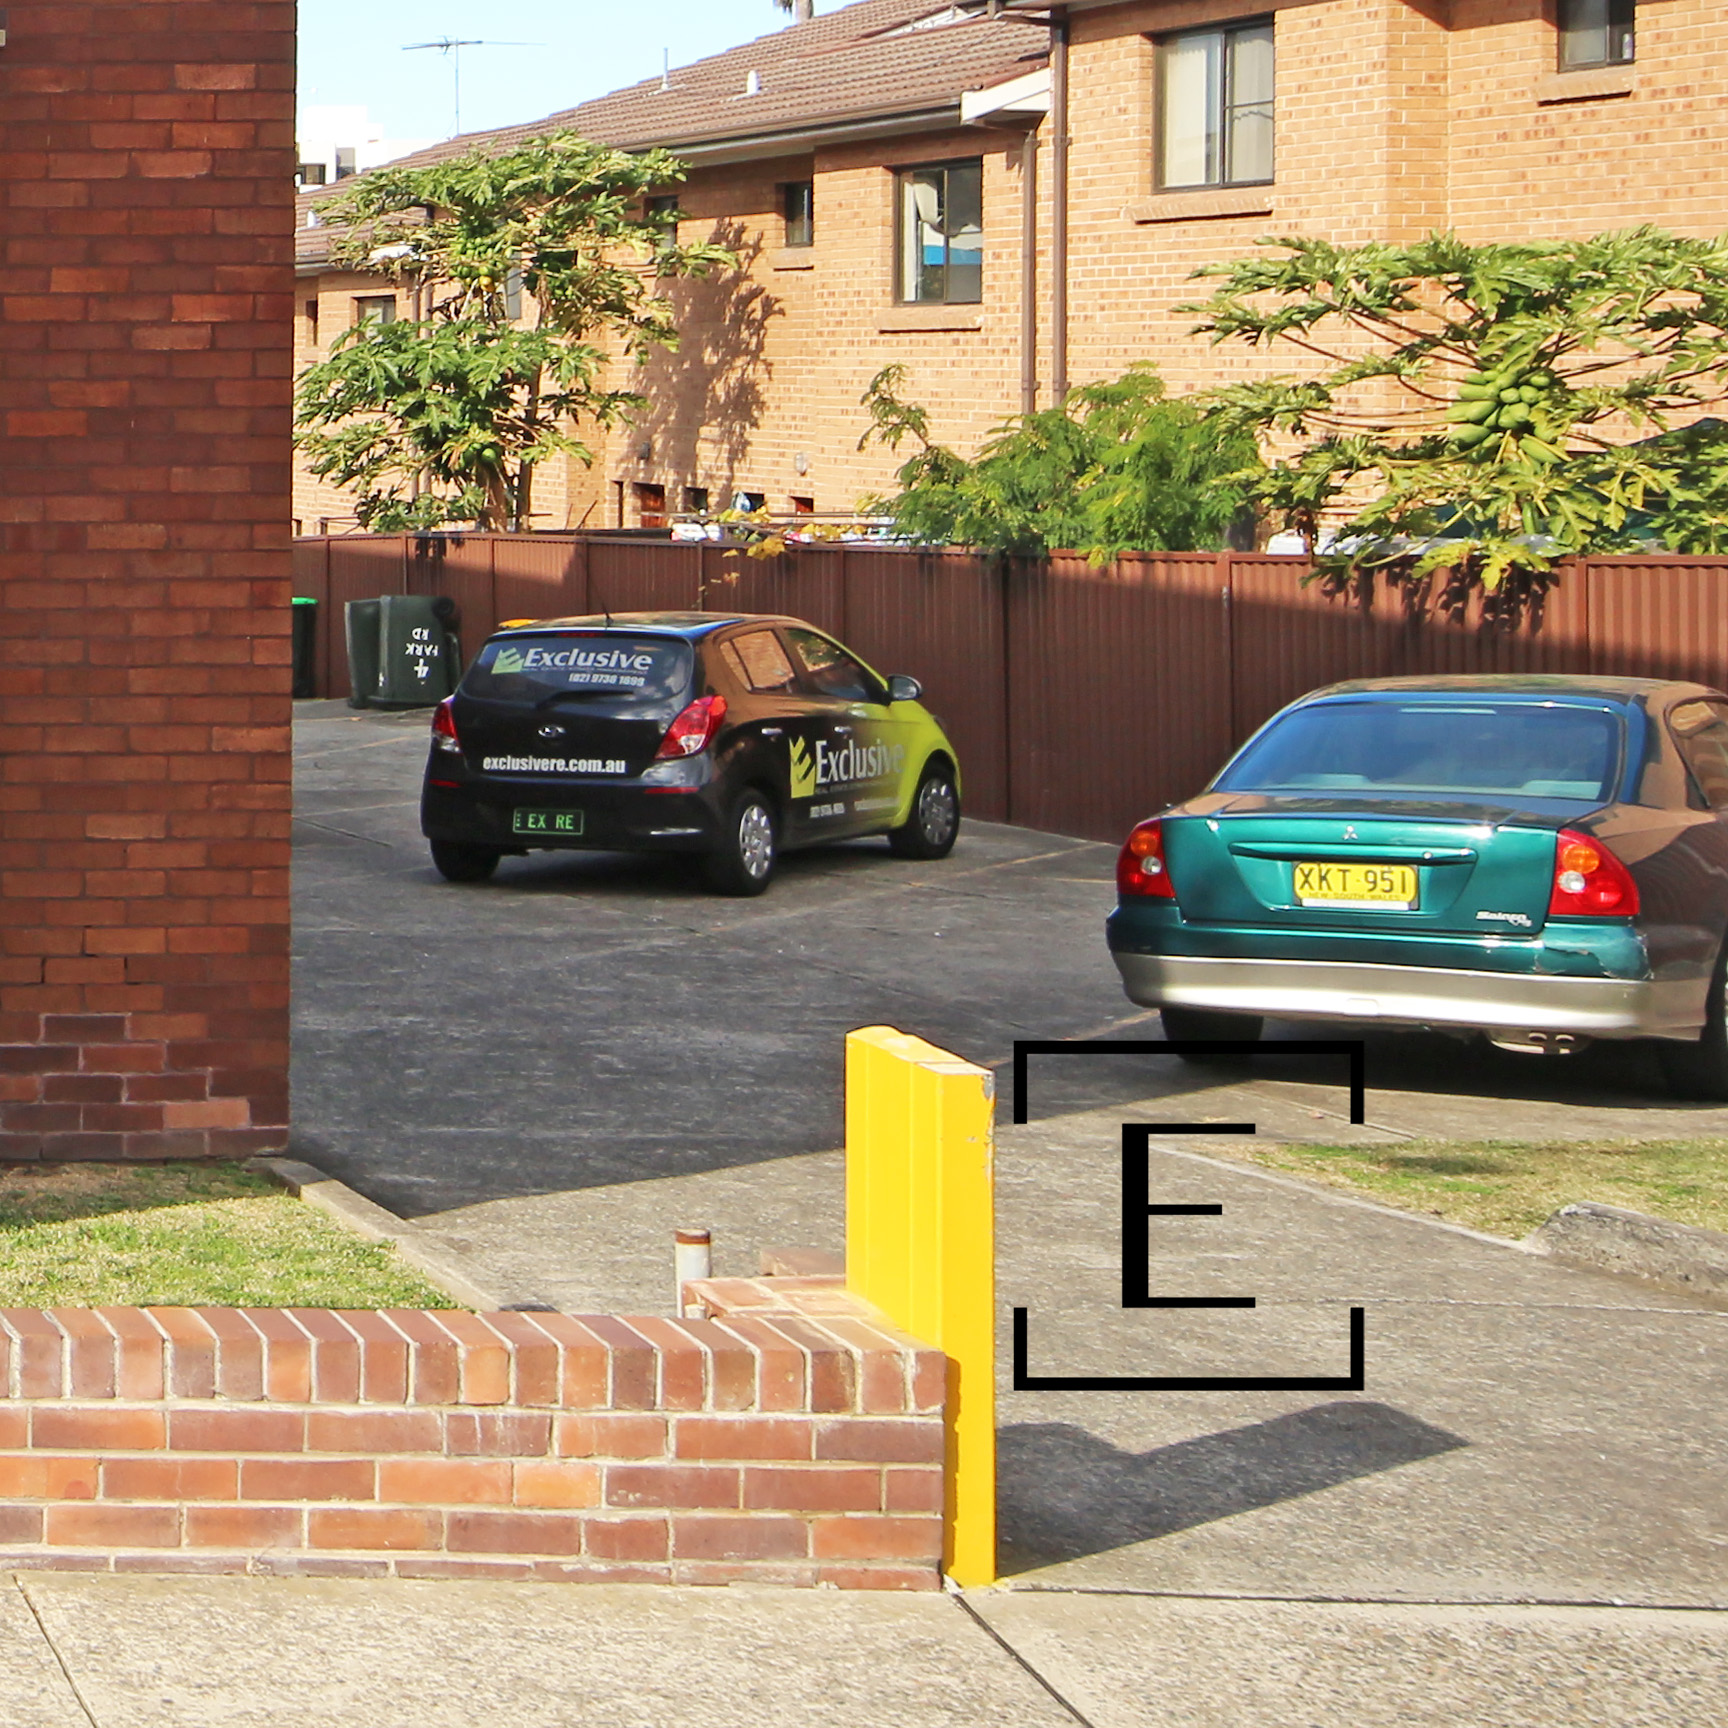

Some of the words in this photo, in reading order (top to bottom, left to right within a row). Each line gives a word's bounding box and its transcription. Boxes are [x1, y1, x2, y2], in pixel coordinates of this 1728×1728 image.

[411, 627, 430, 641] RD
[404, 642, 439, 657] PARK
[523, 647, 653, 671] Exclusive
[413, 658, 430, 678] 4
[618, 676, 646, 687] 1699
[483, 755, 626, 773] exclusivere.com.au
[815, 738, 905, 785] Exclusive
[527, 813, 547, 829] EX
[555, 814, 575, 830] RE
